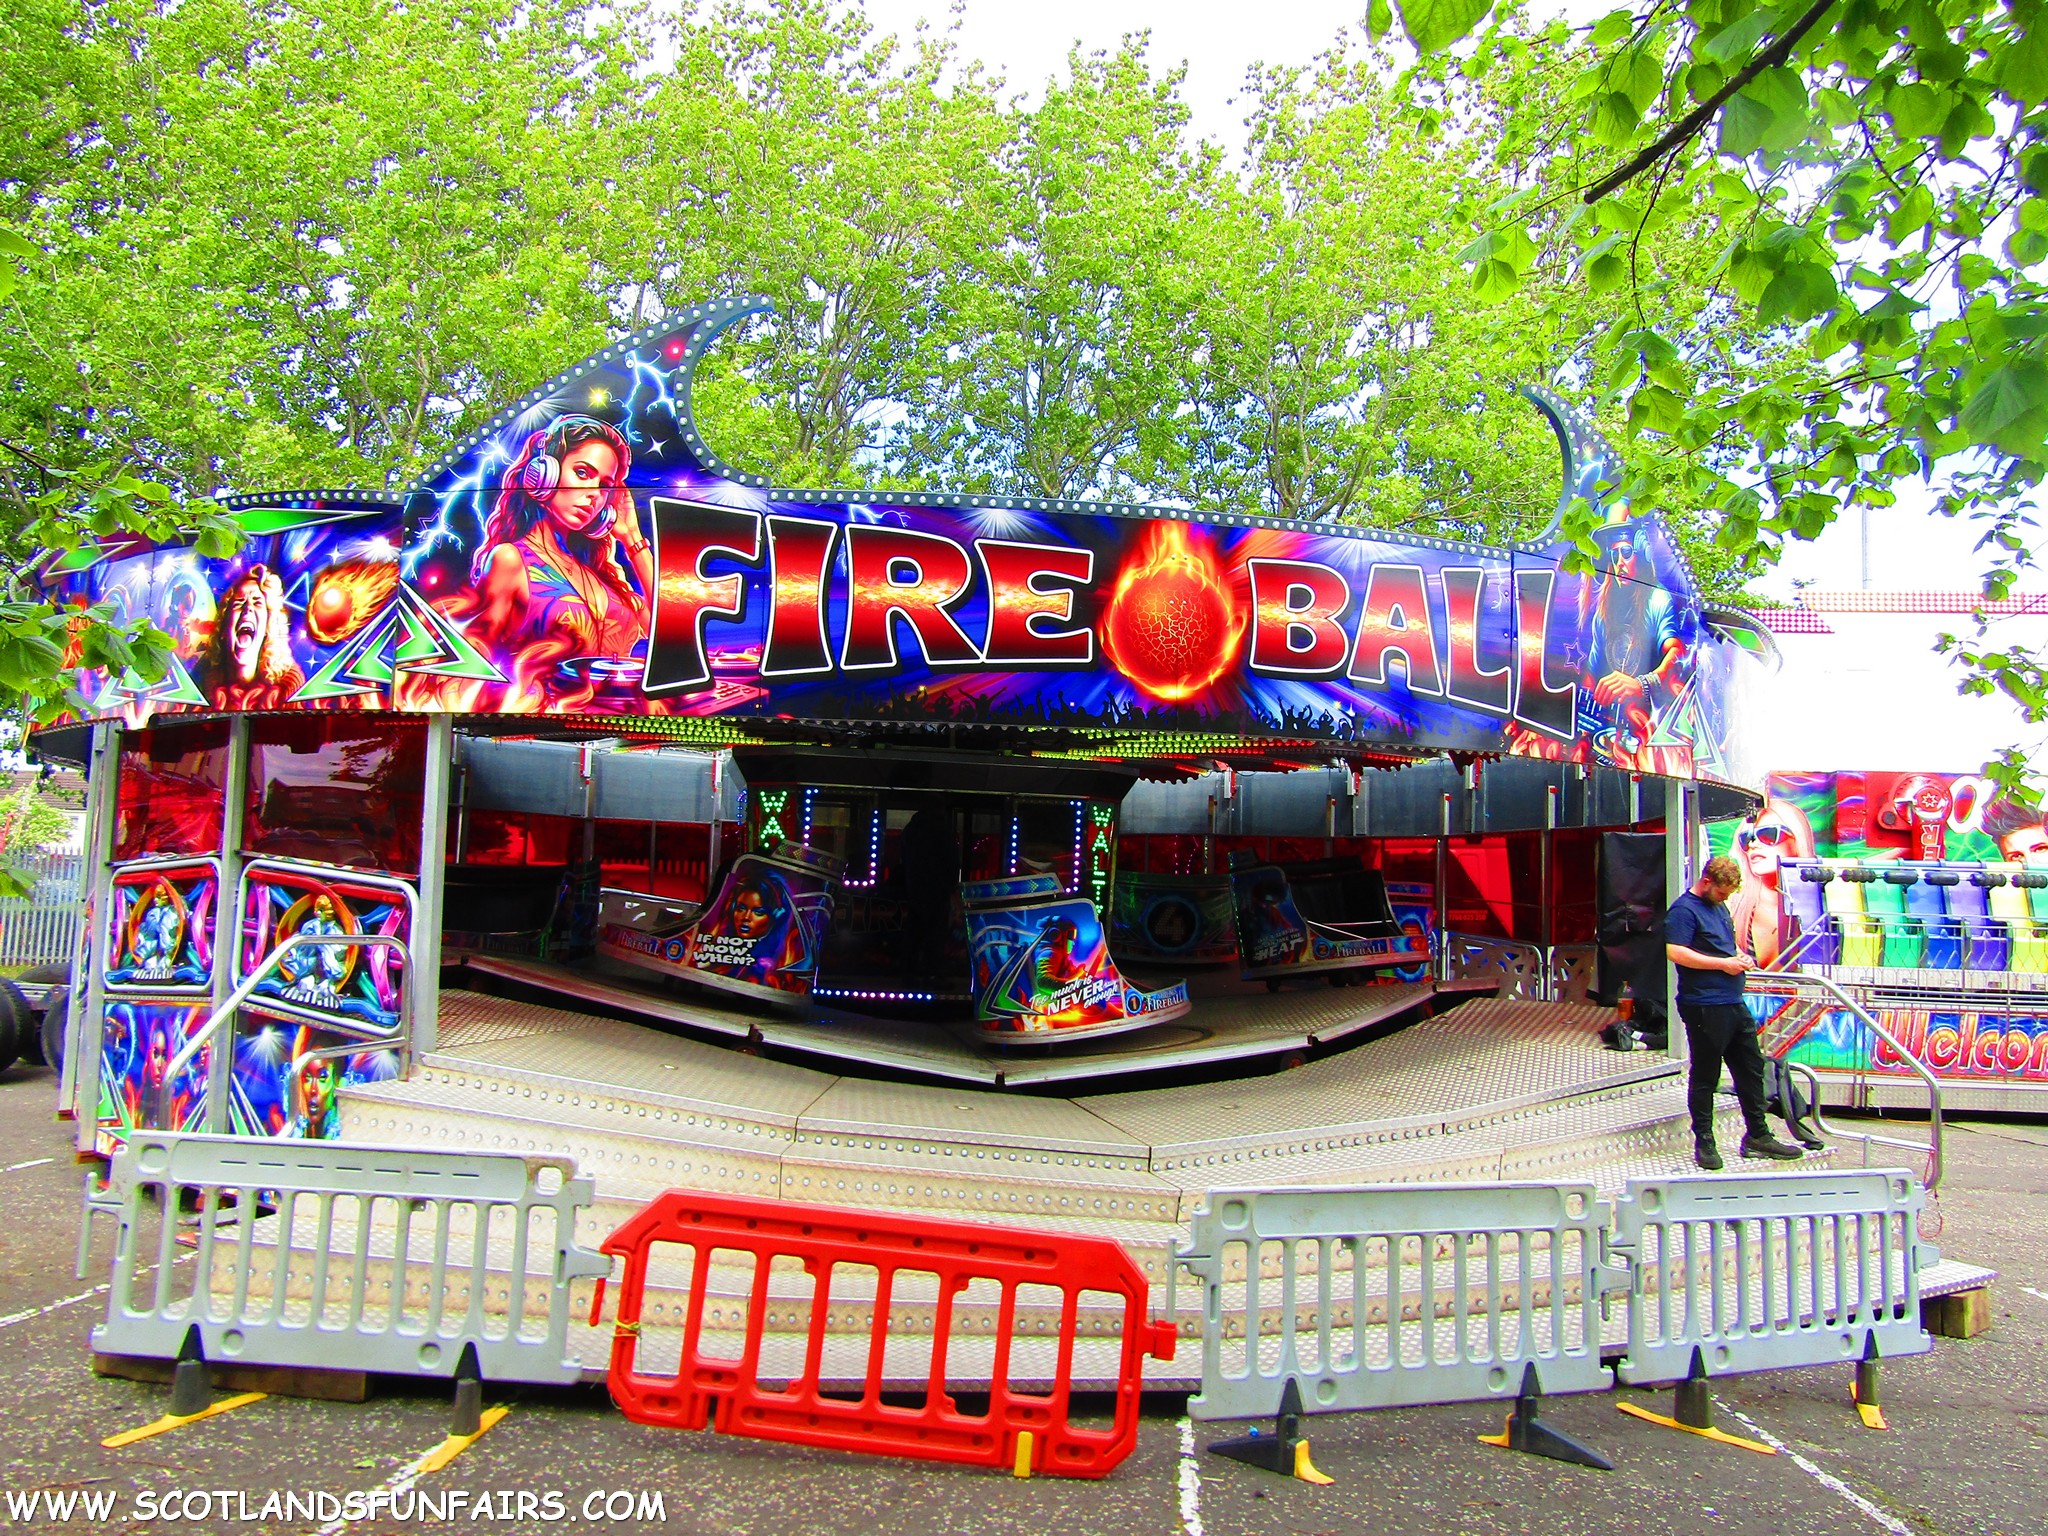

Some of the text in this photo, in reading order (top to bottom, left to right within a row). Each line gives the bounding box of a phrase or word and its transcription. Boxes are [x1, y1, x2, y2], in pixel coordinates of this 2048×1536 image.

[641, 496, 1577, 740] FIRE BALL
[697, 933, 757, 948] IF NOT
[1335, 943, 1385, 957] FIREBALL
[693, 951, 755, 966] WHEN?
[1047, 979, 1105, 1016] NEVER
[1051, 977, 1081, 1000] much
[1083, 973, 1094, 985] is
[1083, 980, 1118, 1009] enough
[1131, 996, 1138, 1010] 1
[1145, 989, 1183, 1012] FIREBALL
